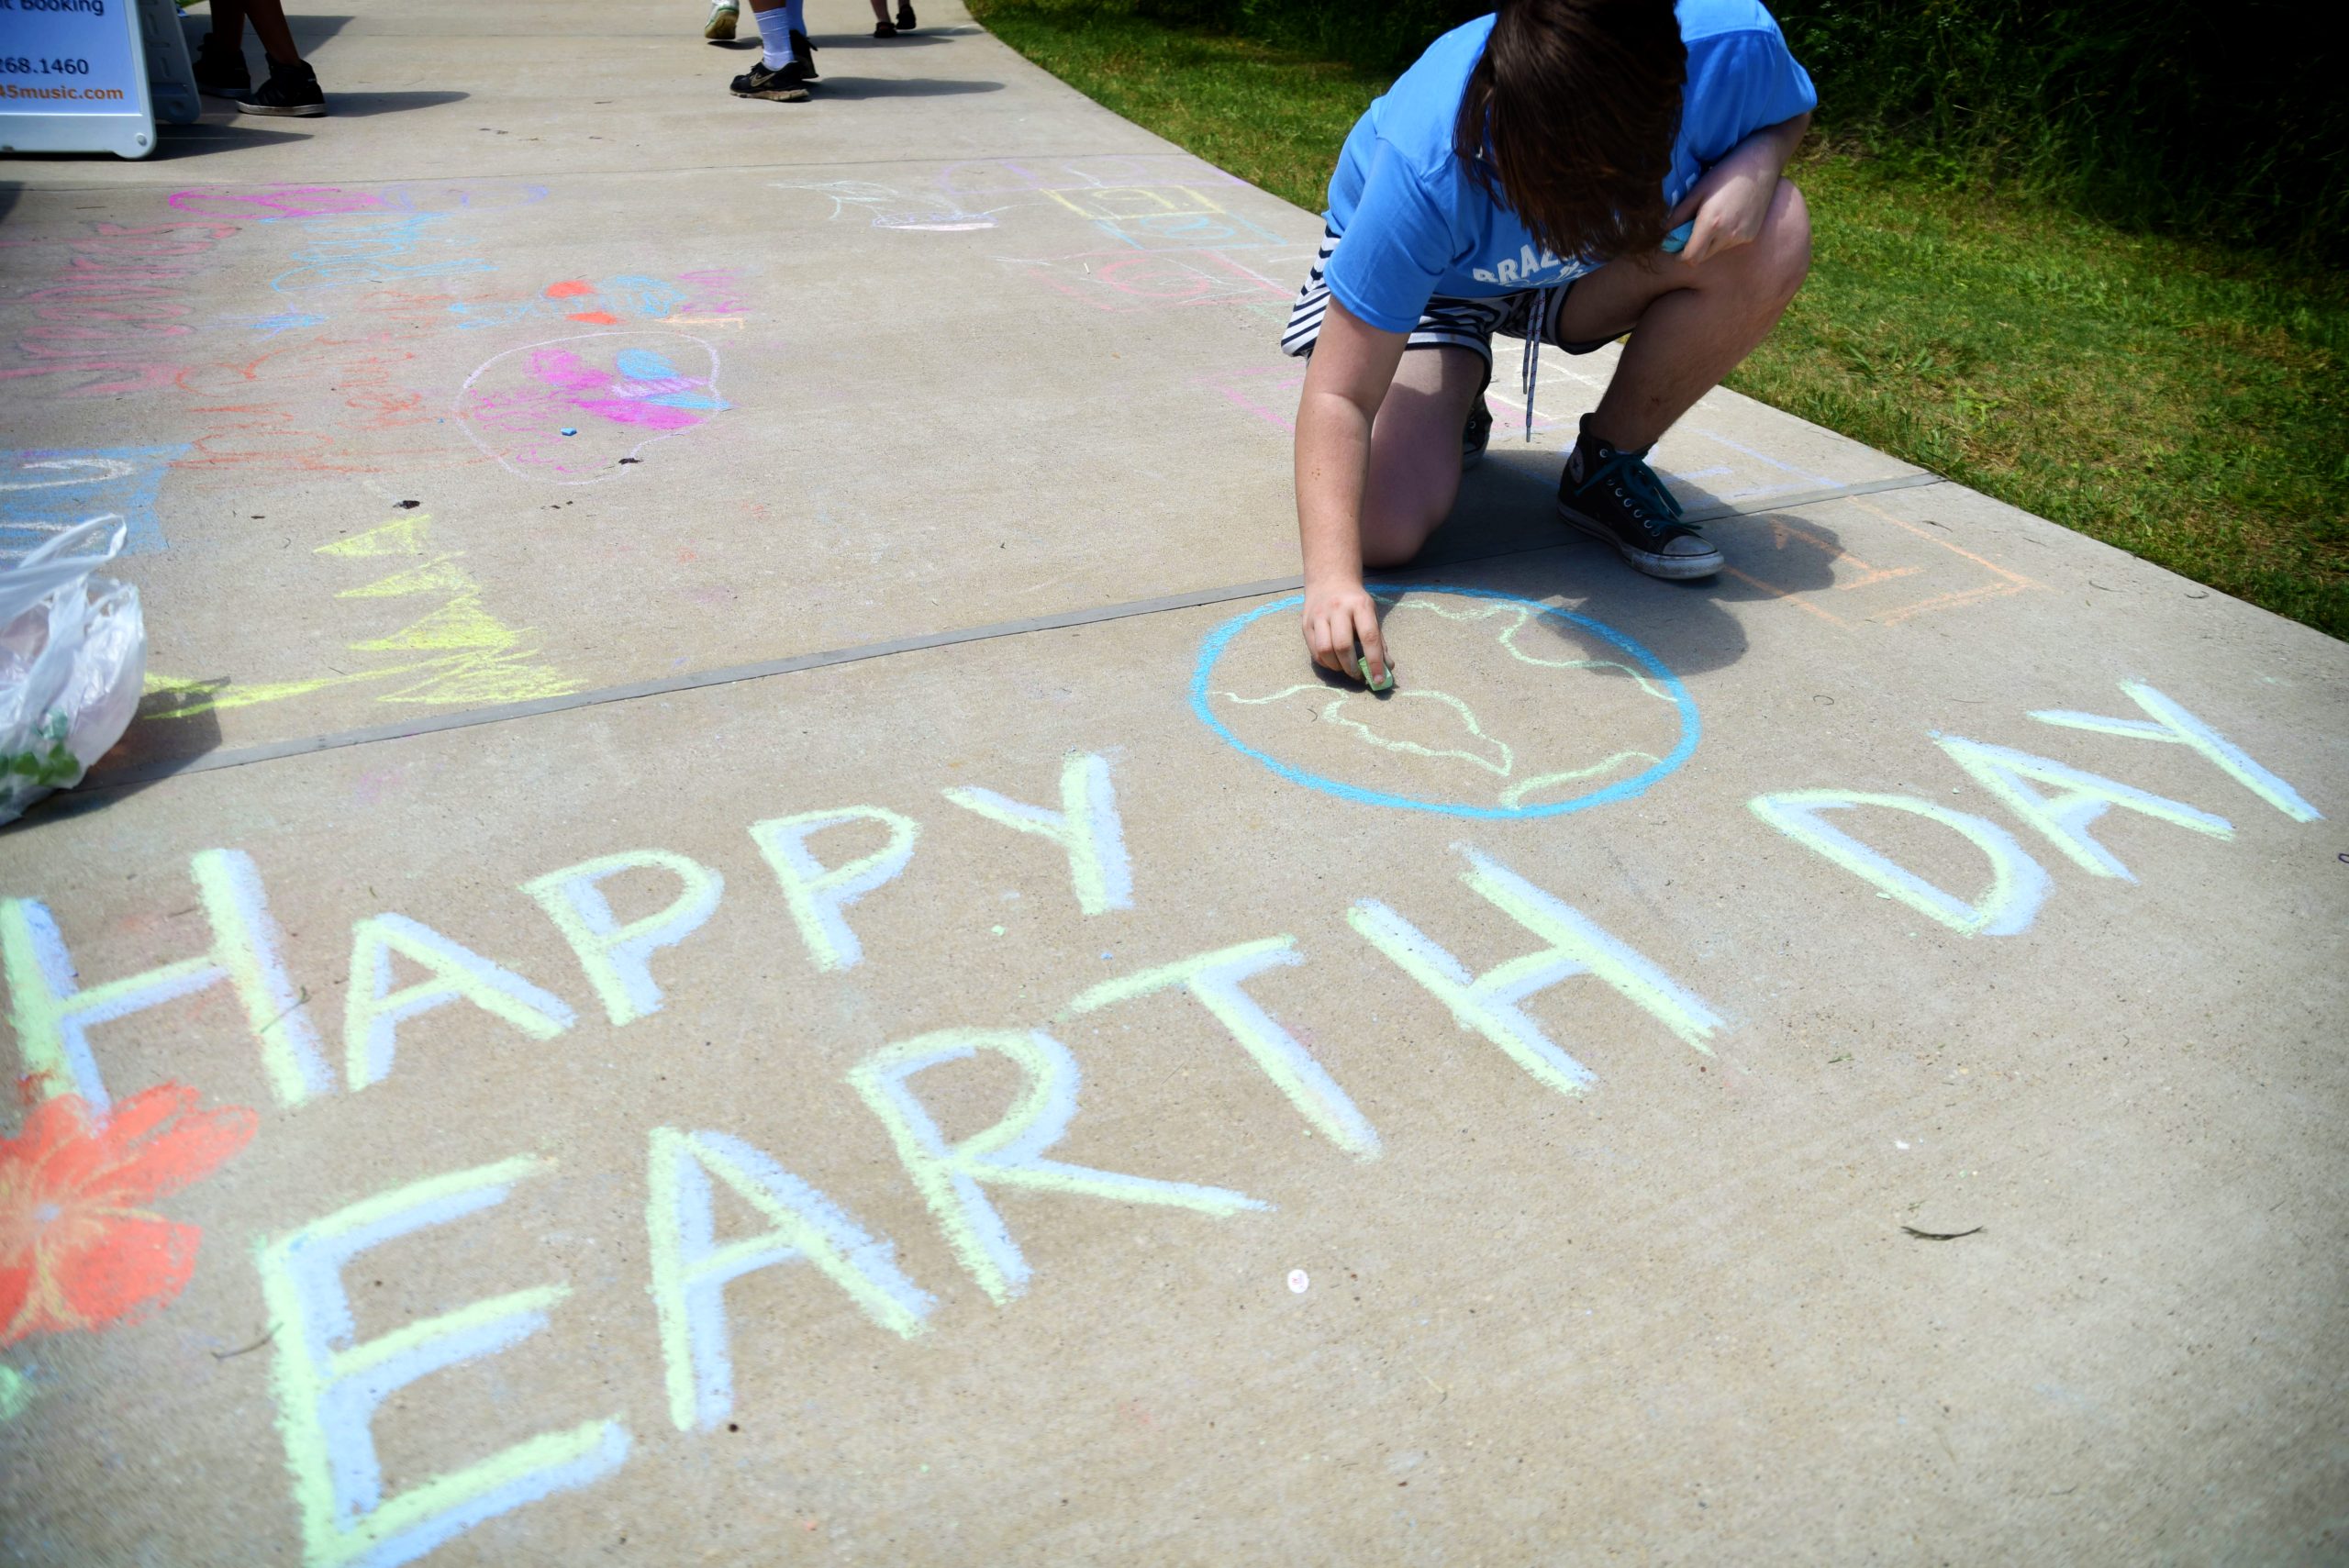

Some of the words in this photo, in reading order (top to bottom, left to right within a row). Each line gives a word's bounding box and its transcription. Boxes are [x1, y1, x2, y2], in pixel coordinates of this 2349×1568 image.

[20, 0, 105, 16] Booking
[0, 744, 1134, 1136] HAPPY
[252, 841, 1730, 1568] EARTH
[1745, 679, 2323, 940] DAY
